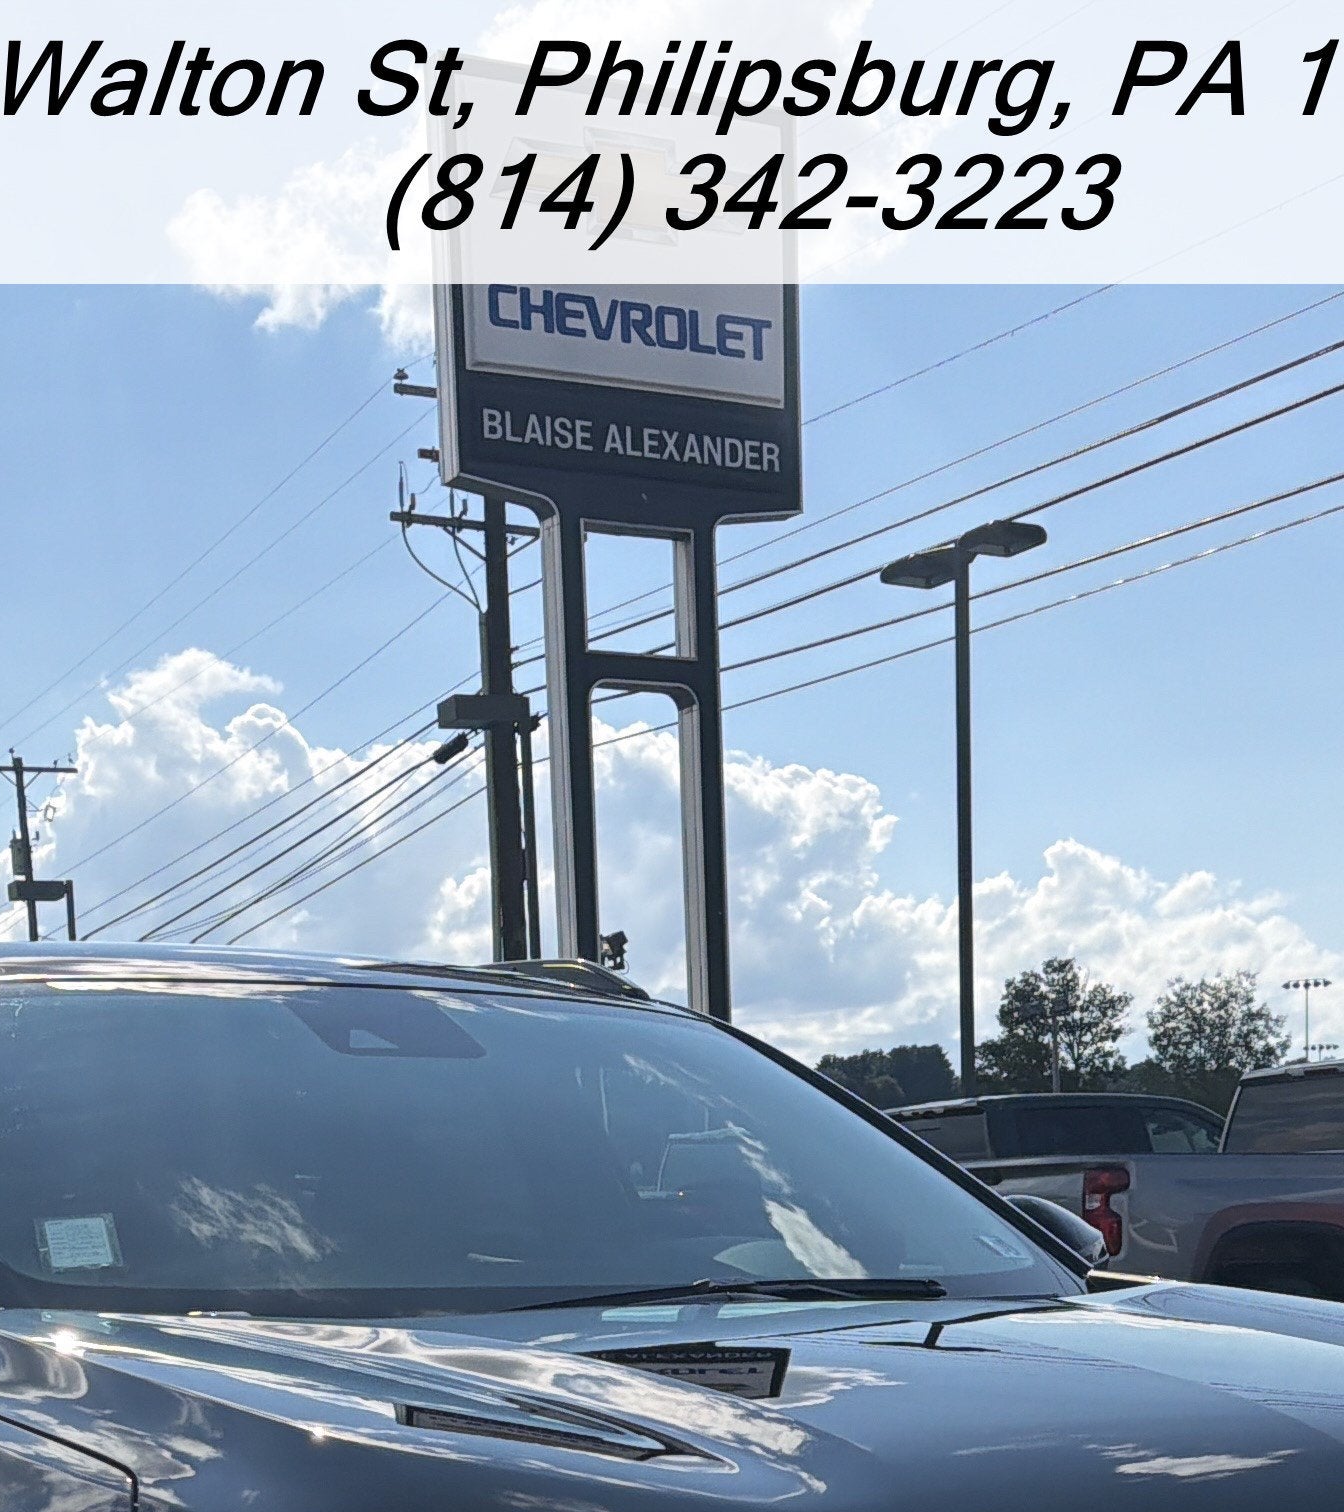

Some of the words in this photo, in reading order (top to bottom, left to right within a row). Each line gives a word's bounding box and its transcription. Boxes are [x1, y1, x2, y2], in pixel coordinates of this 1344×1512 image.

[488, 284, 773, 361] CHEVROLET
[482, 408, 594, 451] BLAISE
[604, 424, 782, 473] ALEXANDER
